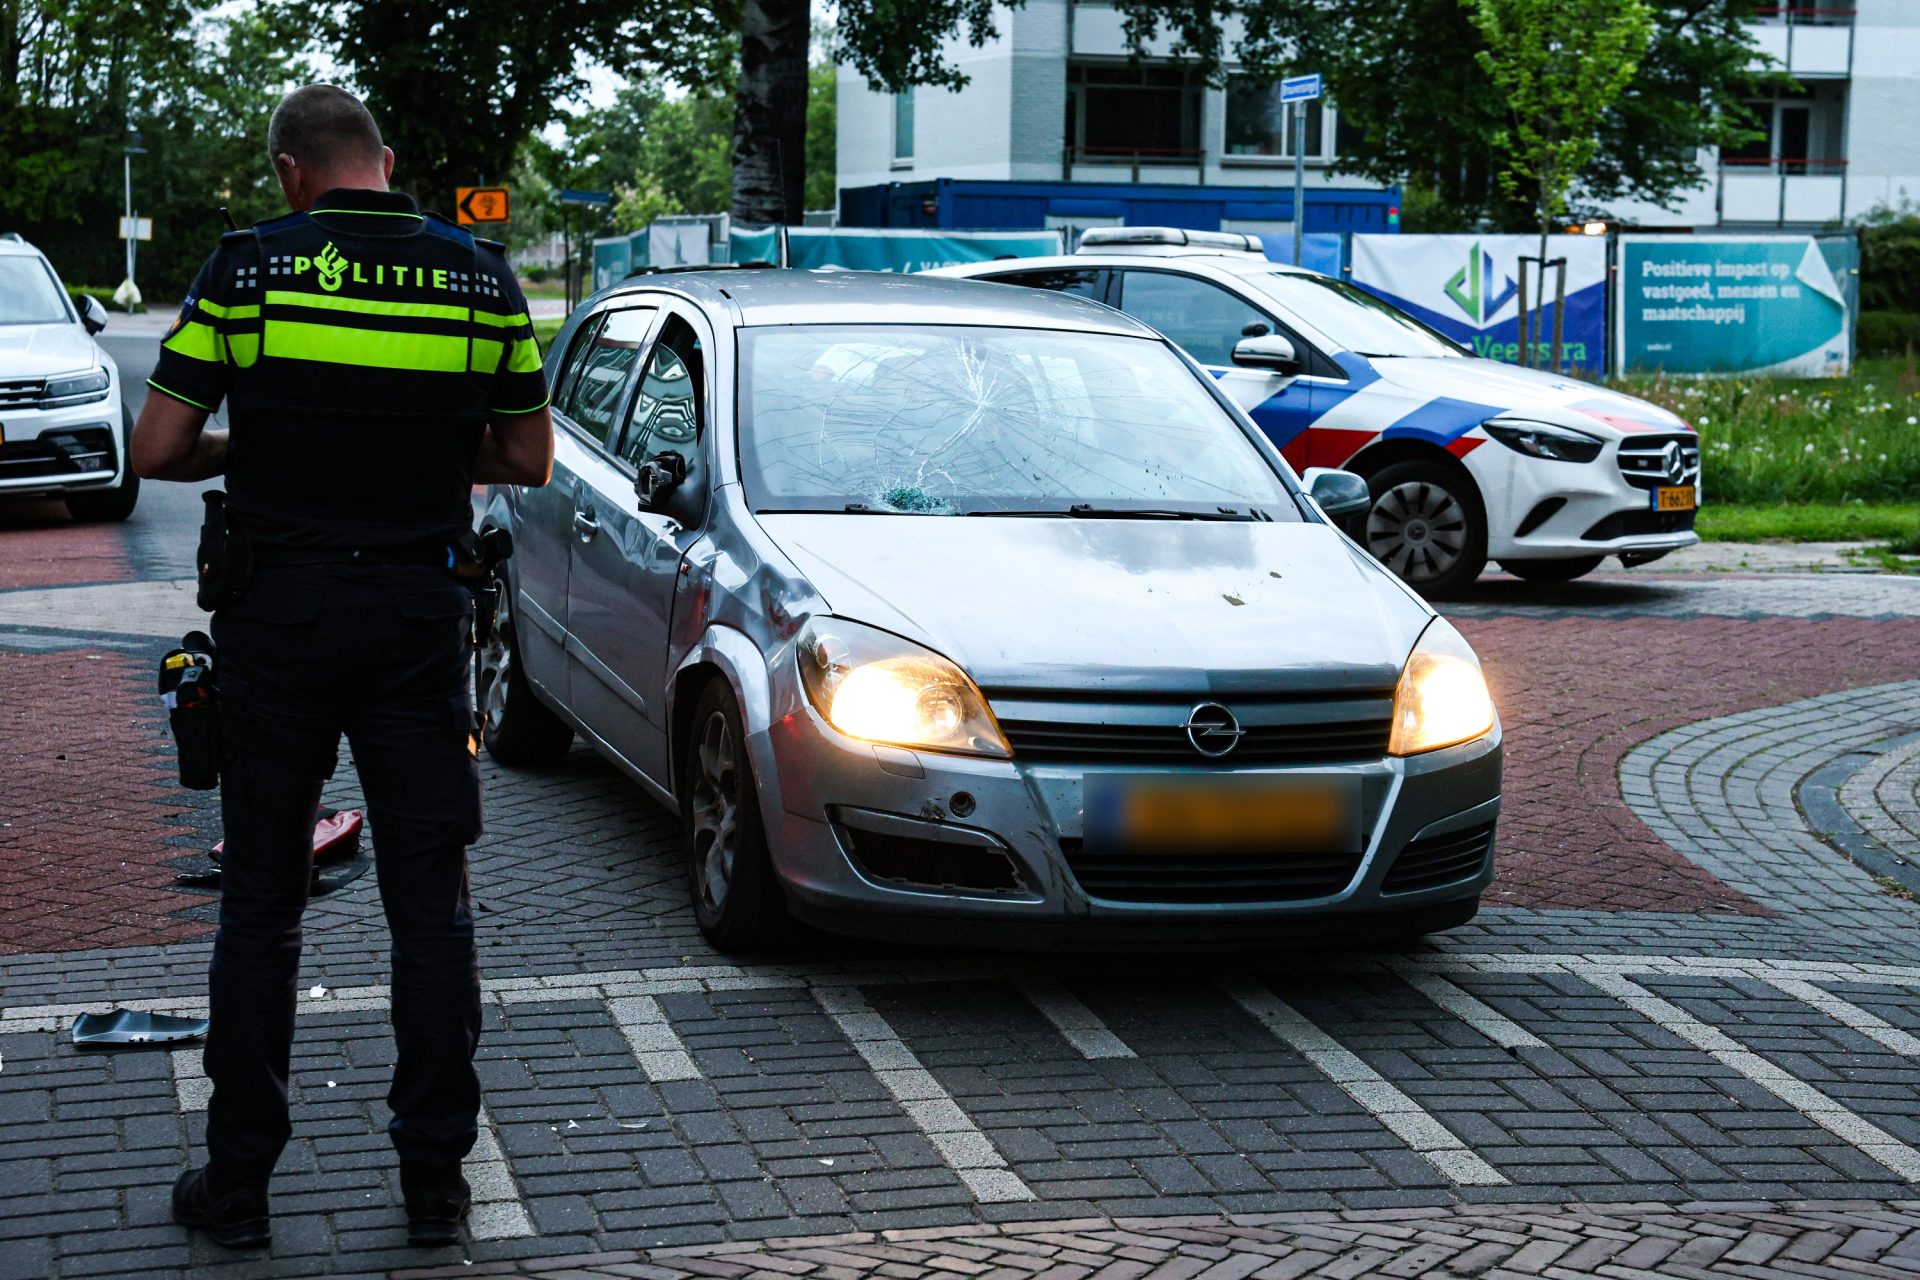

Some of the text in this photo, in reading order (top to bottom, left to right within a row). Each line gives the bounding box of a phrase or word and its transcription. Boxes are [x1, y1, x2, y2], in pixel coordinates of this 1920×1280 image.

[1642, 258, 1790, 279] Positieve impact op
[1642, 282, 1799, 301] vastgoed, mensen en
[1642, 304, 1745, 324] maatschappij
